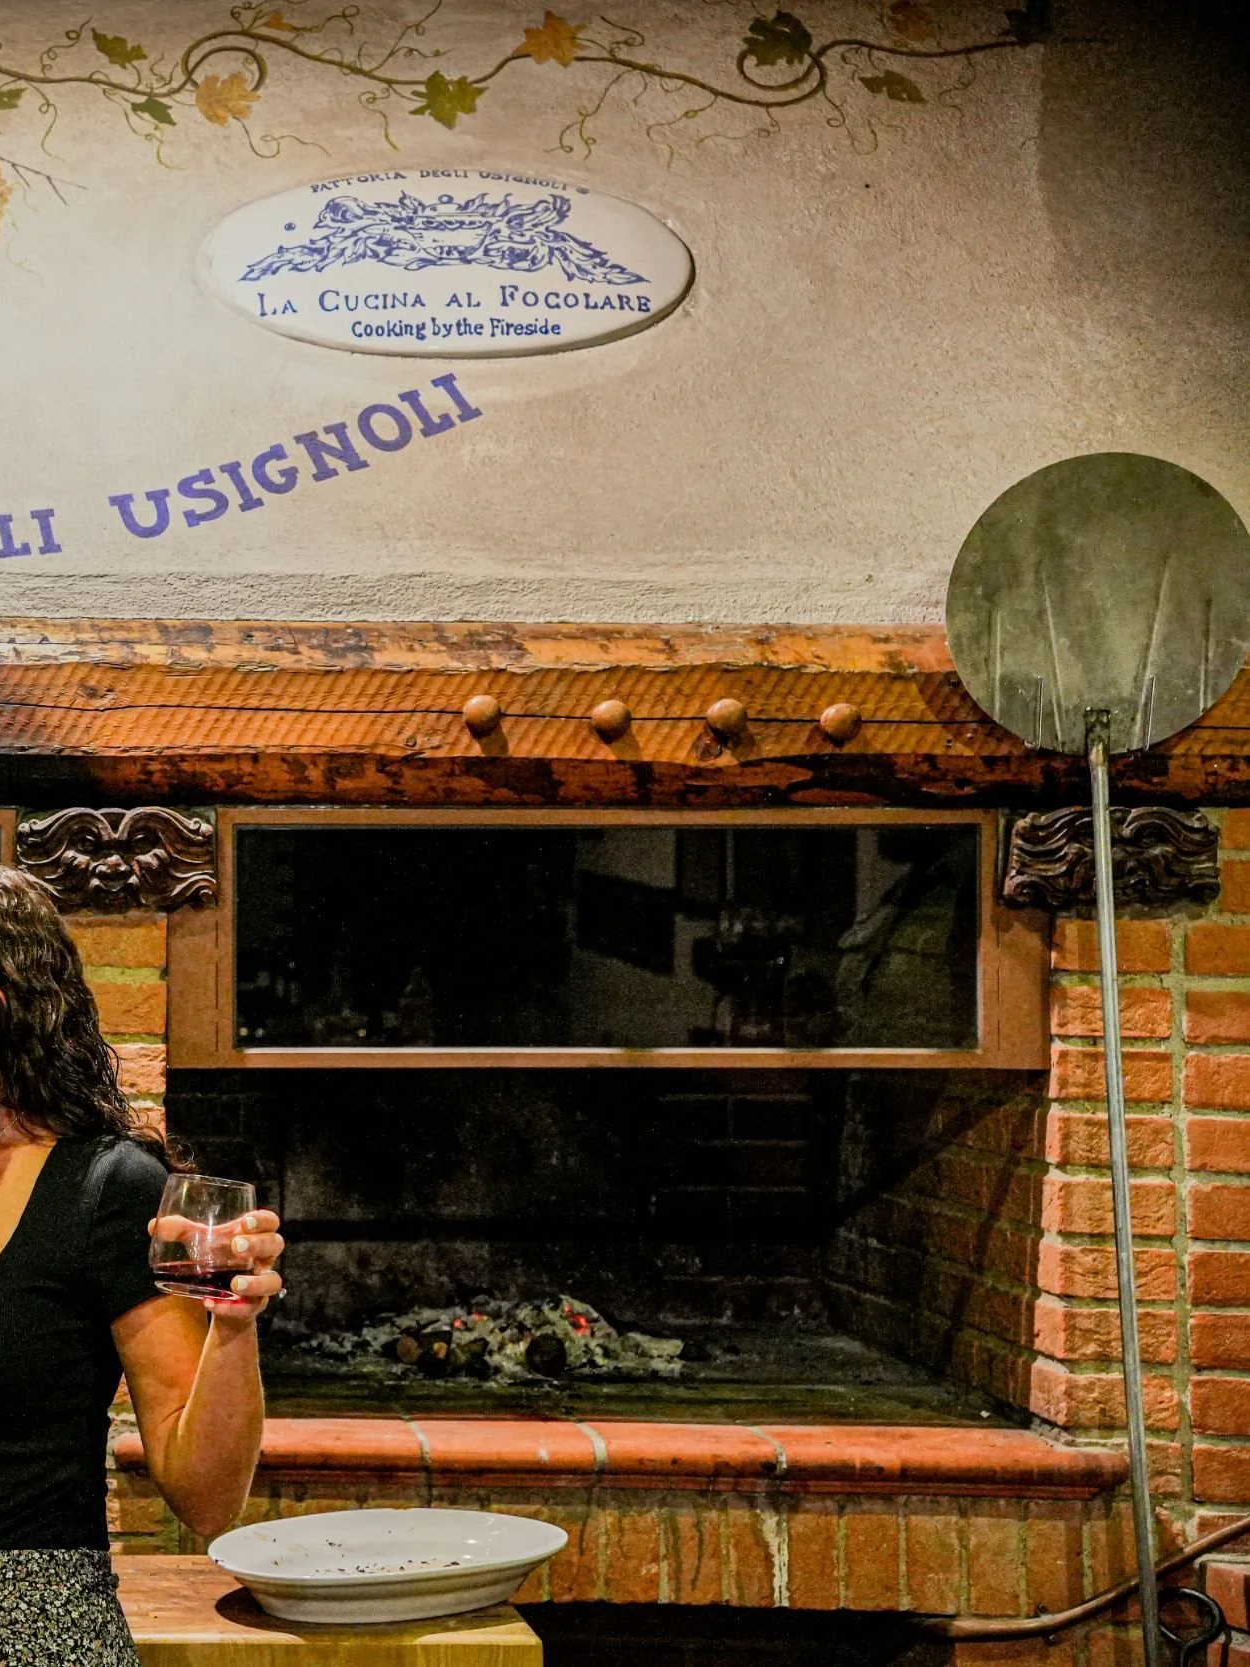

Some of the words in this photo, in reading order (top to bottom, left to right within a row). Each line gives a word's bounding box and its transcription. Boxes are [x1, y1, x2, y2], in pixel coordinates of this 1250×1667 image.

[420, 168, 469, 179] DEGLI
[351, 320, 428, 341] Cooking
[431, 318, 454, 339] by
[456, 318, 485, 336] the
[489, 318, 562, 338] Fireside
[109, 374, 482, 539] USIGNOLI
